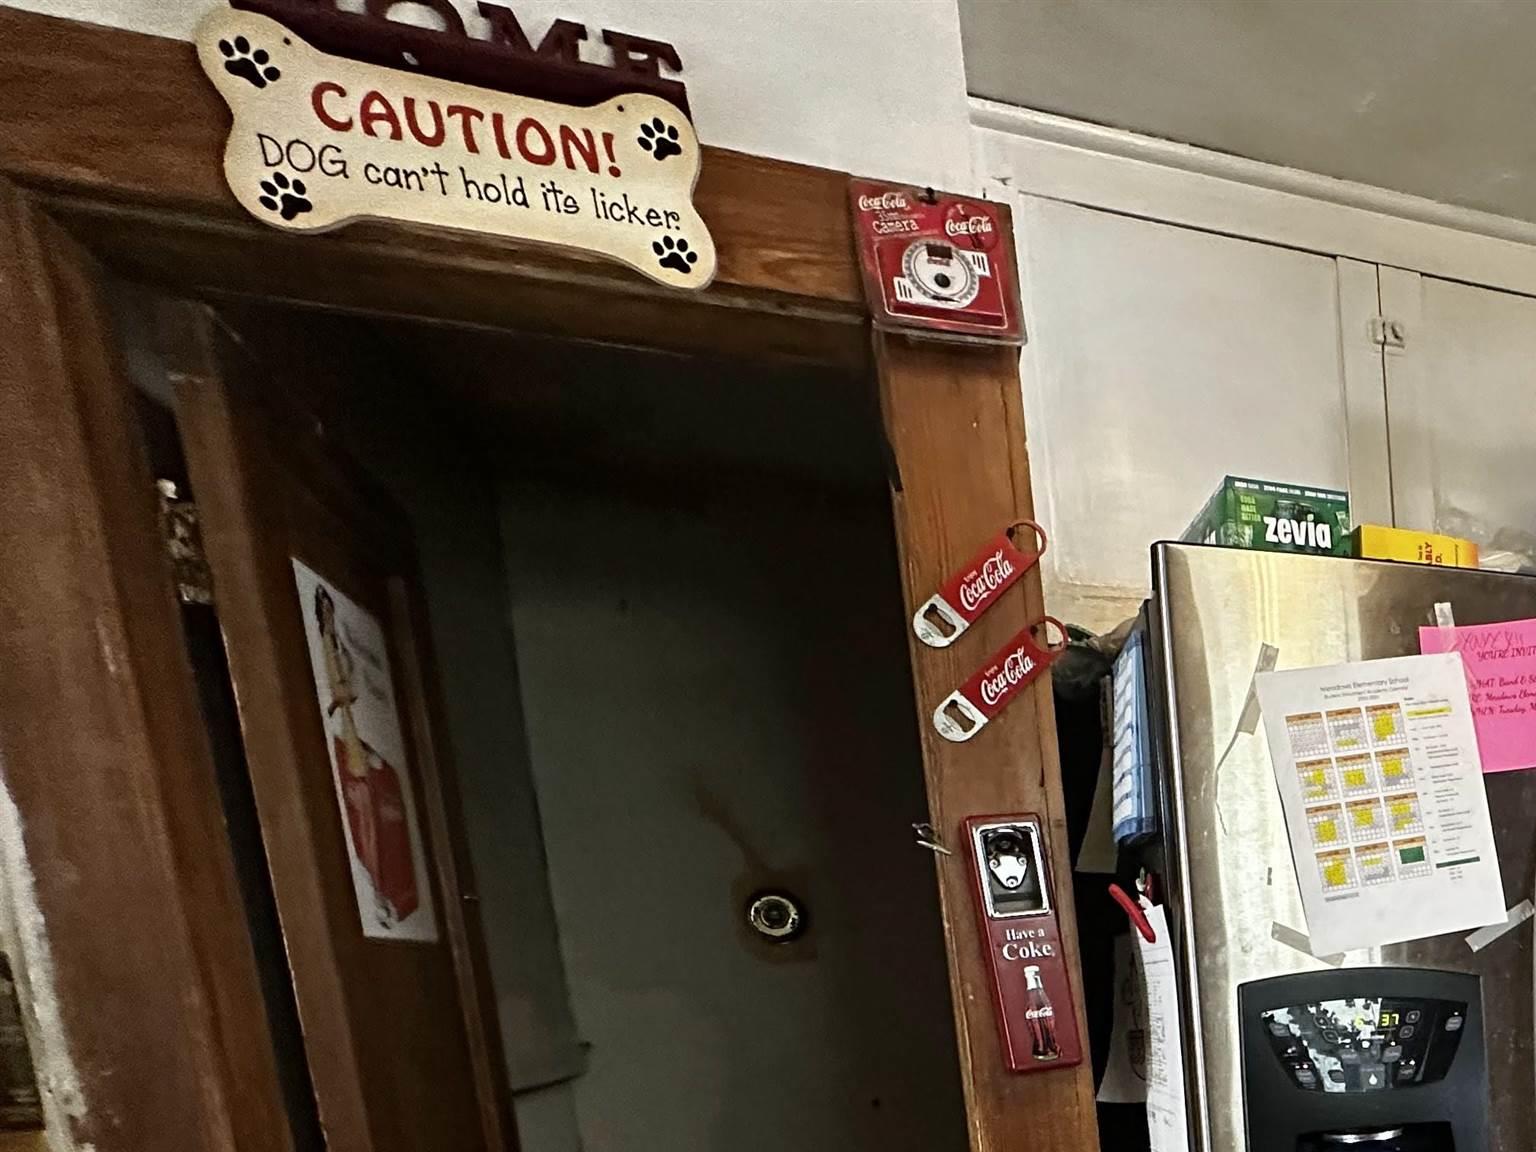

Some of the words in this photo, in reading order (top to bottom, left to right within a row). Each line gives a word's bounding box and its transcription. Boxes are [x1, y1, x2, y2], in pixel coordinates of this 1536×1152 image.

[311, 80, 623, 179] CAUTION!
[257, 132, 350, 180] DOG
[364, 158, 450, 198] can't
[465, 166, 530, 210] hold
[540, 180, 580, 217] its
[945, 215, 993, 237] Coca-Cola
[1263, 513, 1333, 549] zevia
[959, 548, 1015, 612] Coca-Cola
[980, 645, 1037, 706] Coca-Cola
[1002, 941, 1053, 961] Coke
[1004, 928, 1035, 942] Have
[1036, 930, 1045, 939] a
[1381, 1013, 1400, 1027] 37
